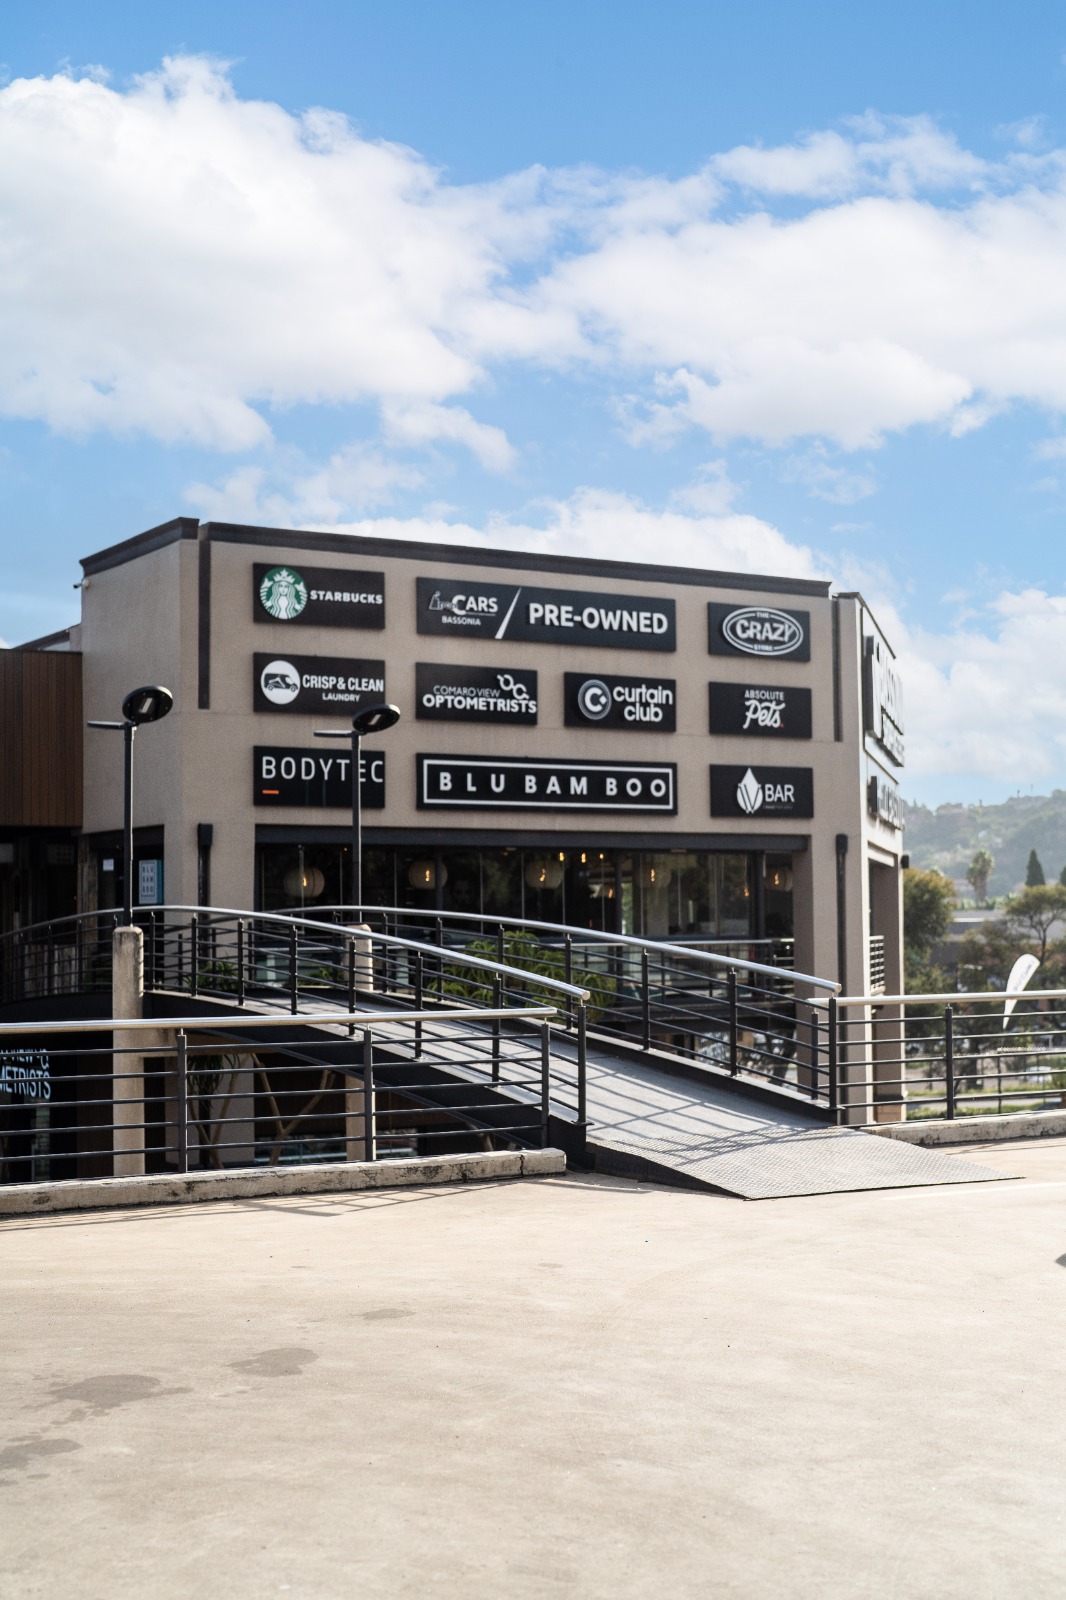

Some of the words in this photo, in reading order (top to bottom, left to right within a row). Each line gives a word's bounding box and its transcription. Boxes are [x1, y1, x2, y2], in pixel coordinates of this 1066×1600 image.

[310, 590, 383, 604] STARBUCKS
[452, 595, 498, 615] CARS
[442, 615, 481, 625] BASSONIA
[529, 602, 668, 634] PRE-OWNED
[736, 619, 795, 642] CRAZY
[302, 674, 336, 690] CRISP
[347, 677, 384, 692] CLEAN
[433, 685, 477, 697] COMARO
[477, 688, 500, 698] VIEW
[322, 693, 360, 702] LAUNDRY
[422, 693, 537, 713] OPTOMETRISTS
[613, 684, 673, 705] curtain
[744, 689, 784, 701] ABSOLUTE
[623, 702, 663, 722] club
[439, 771, 505, 793] BLU
[524, 774, 588, 795] BAM
[605, 777, 667, 797] BOO
